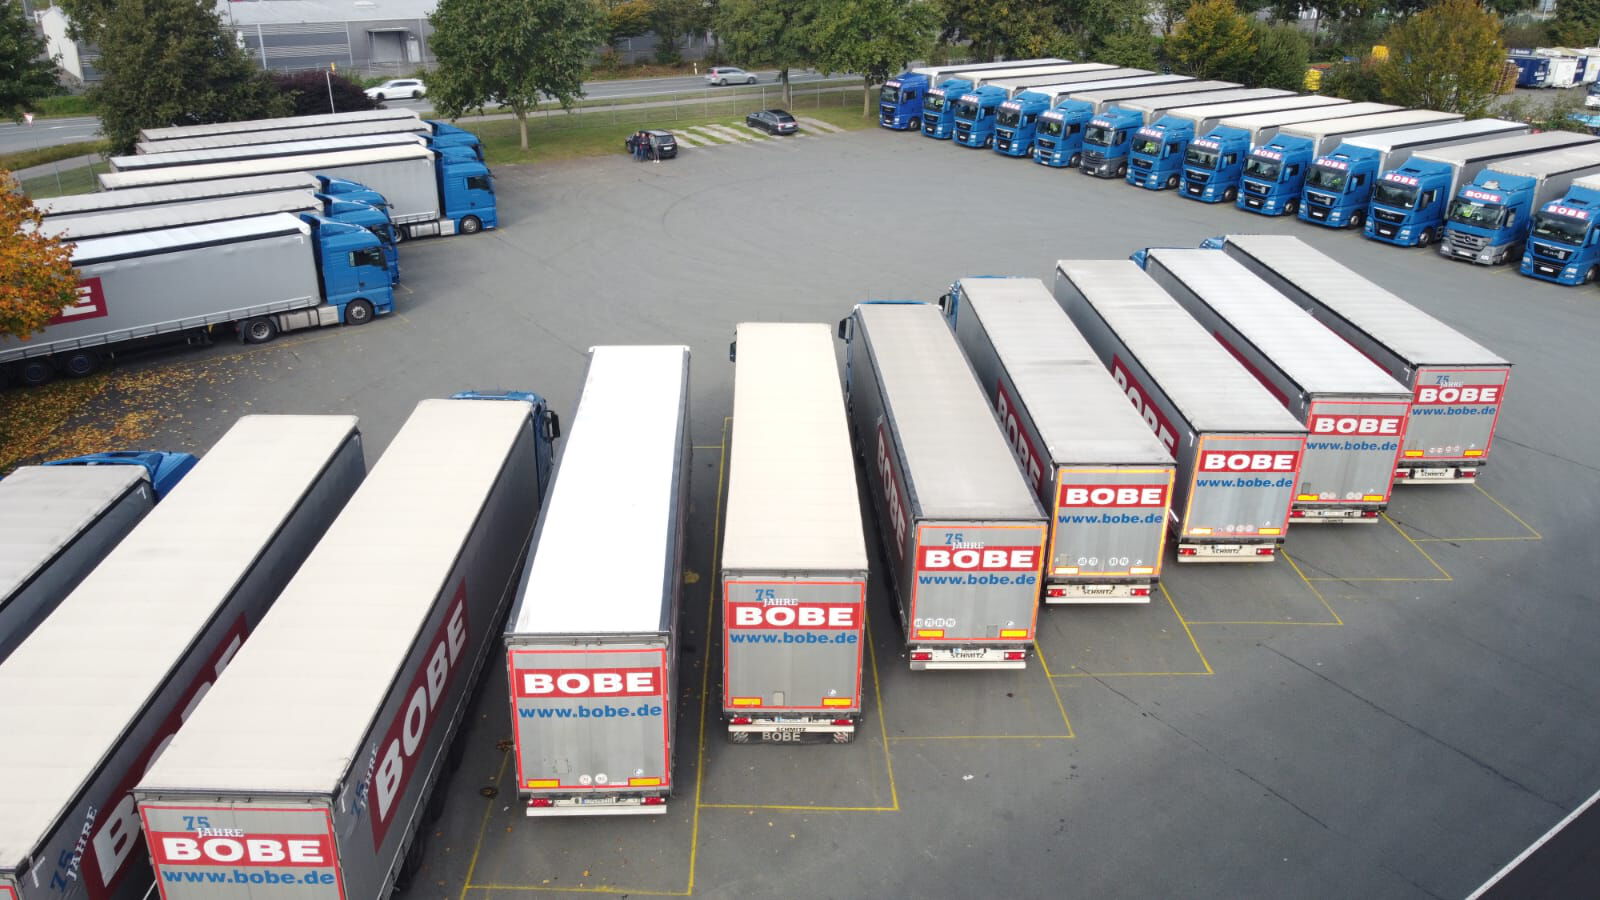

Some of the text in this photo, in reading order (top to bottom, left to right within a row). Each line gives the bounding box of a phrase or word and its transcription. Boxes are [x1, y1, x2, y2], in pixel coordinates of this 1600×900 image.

[1385, 174, 1418, 185] BOBE
[1465, 190, 1499, 202] BOBE
[1548, 205, 1587, 219] BOBE
[1436, 375, 1450, 384] 75
[1418, 388, 1499, 403] BOBE
[1412, 406, 1496, 415] www.bobe.de
[1314, 418, 1399, 433] BOBE
[1306, 441, 1397, 450] www.bobe.de
[1204, 454, 1294, 470] BOBE
[1197, 478, 1293, 487] www.bobe.de
[877, 431, 906, 560] BOBE
[1066, 488, 1162, 505] BOBE
[1058, 513, 1163, 524] www.bobe.de
[945, 533, 963, 545] 75
[925, 550, 1034, 568] BOBE
[919, 574, 1036, 585] www.bobe.de
[755, 589, 775, 601] 75
[736, 607, 853, 627] BOBE
[730, 632, 857, 644] www.bobe.de
[524, 672, 654, 694] BOBE
[375, 599, 466, 823] BOBE
[519, 704, 662, 718] www.bobe.de
[762, 732, 801, 742] BOBE
[183, 816, 211, 831] 75
[196, 828, 244, 838] JAHRE
[66, 806, 97, 881] JAHRE
[162, 837, 324, 863] BOBE
[162, 870, 335, 884] www.bobe.de
